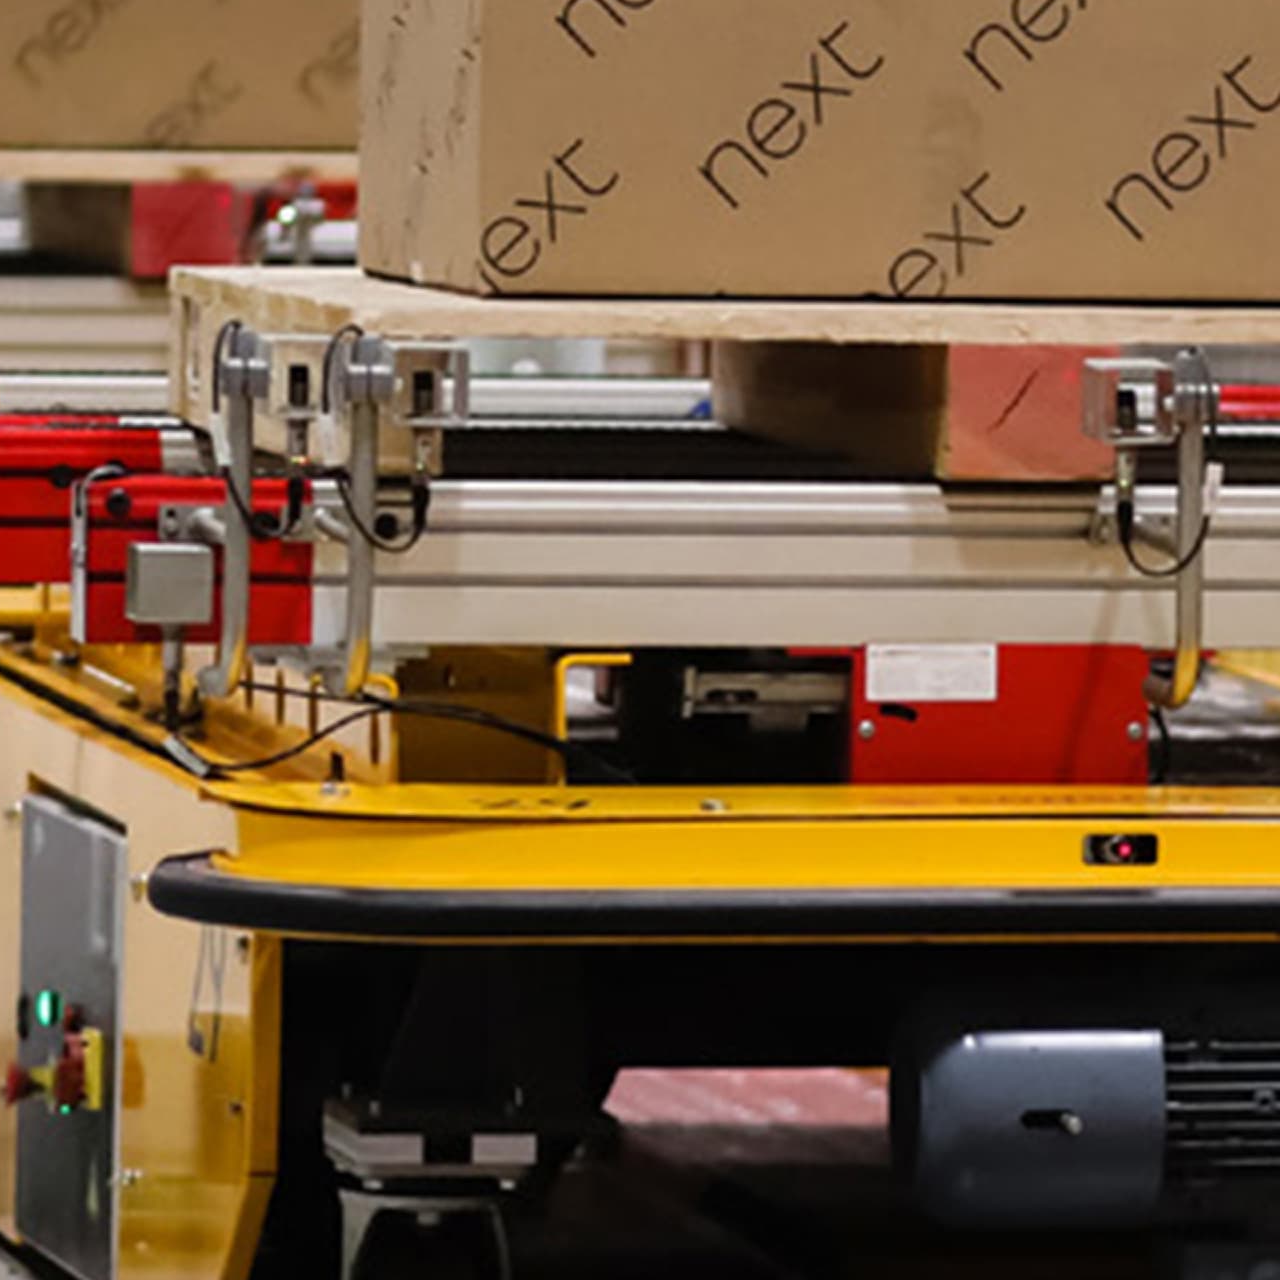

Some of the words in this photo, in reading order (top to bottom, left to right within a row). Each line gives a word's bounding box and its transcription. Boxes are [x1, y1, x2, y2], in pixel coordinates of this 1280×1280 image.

[144, 57, 244, 146] ext
[698, 22, 885, 210] next
[478, 138, 619, 294] ext
[886, 171, 1027, 297] ext
